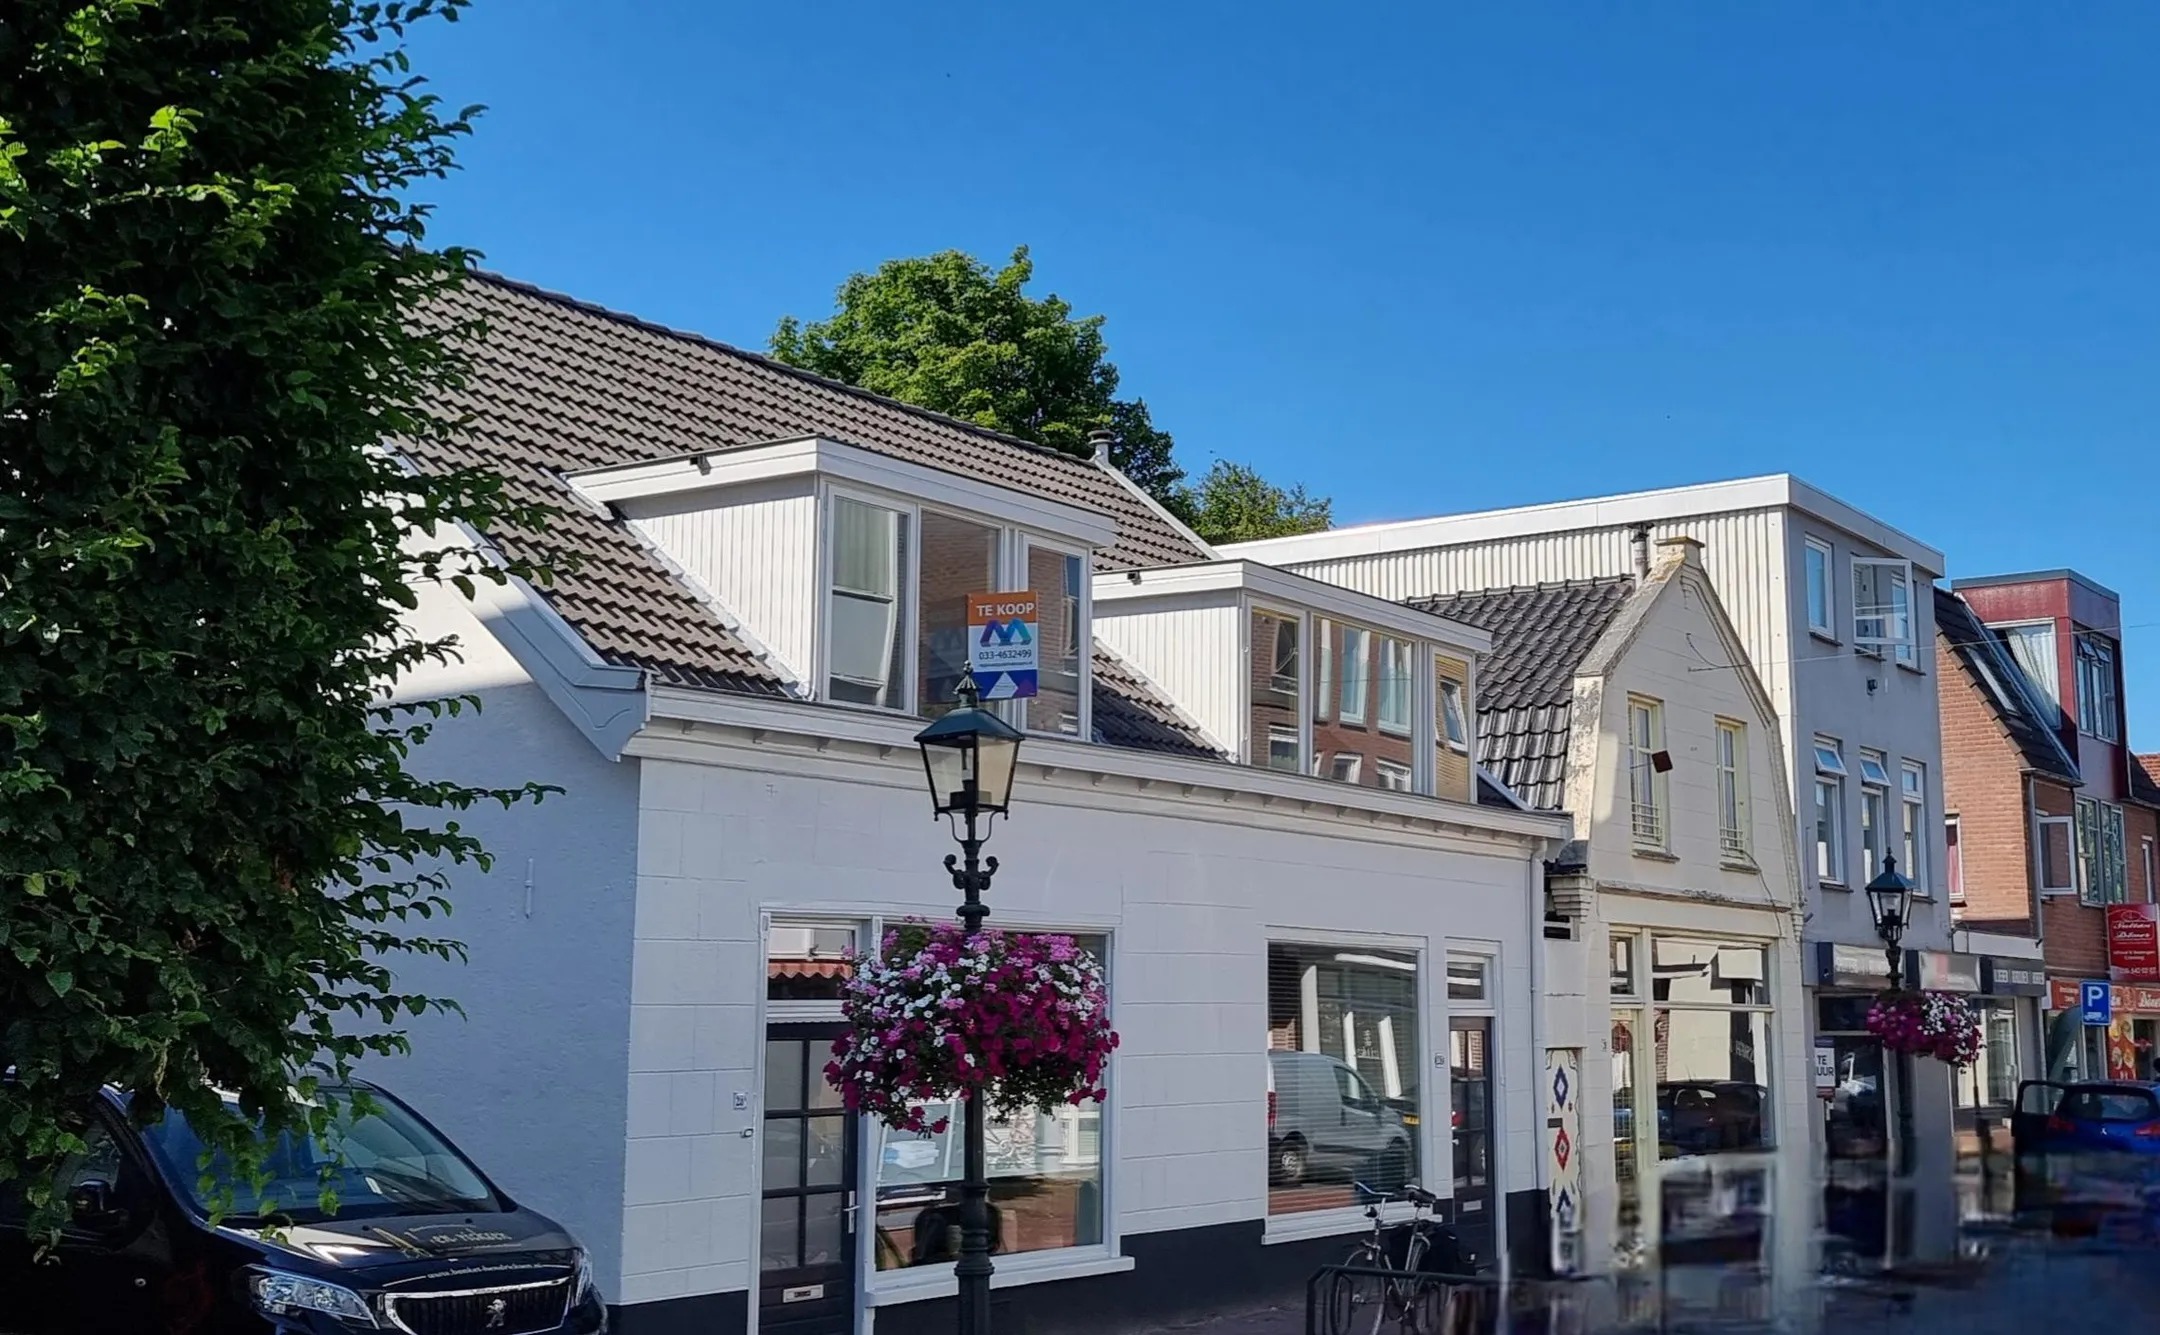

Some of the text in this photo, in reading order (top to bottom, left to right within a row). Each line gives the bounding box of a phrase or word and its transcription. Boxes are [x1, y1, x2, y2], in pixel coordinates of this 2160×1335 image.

[977, 603, 1034, 616] TE KOOP
[2087, 986, 2103, 1007] P
[1817, 1055, 1827, 1065] TE
